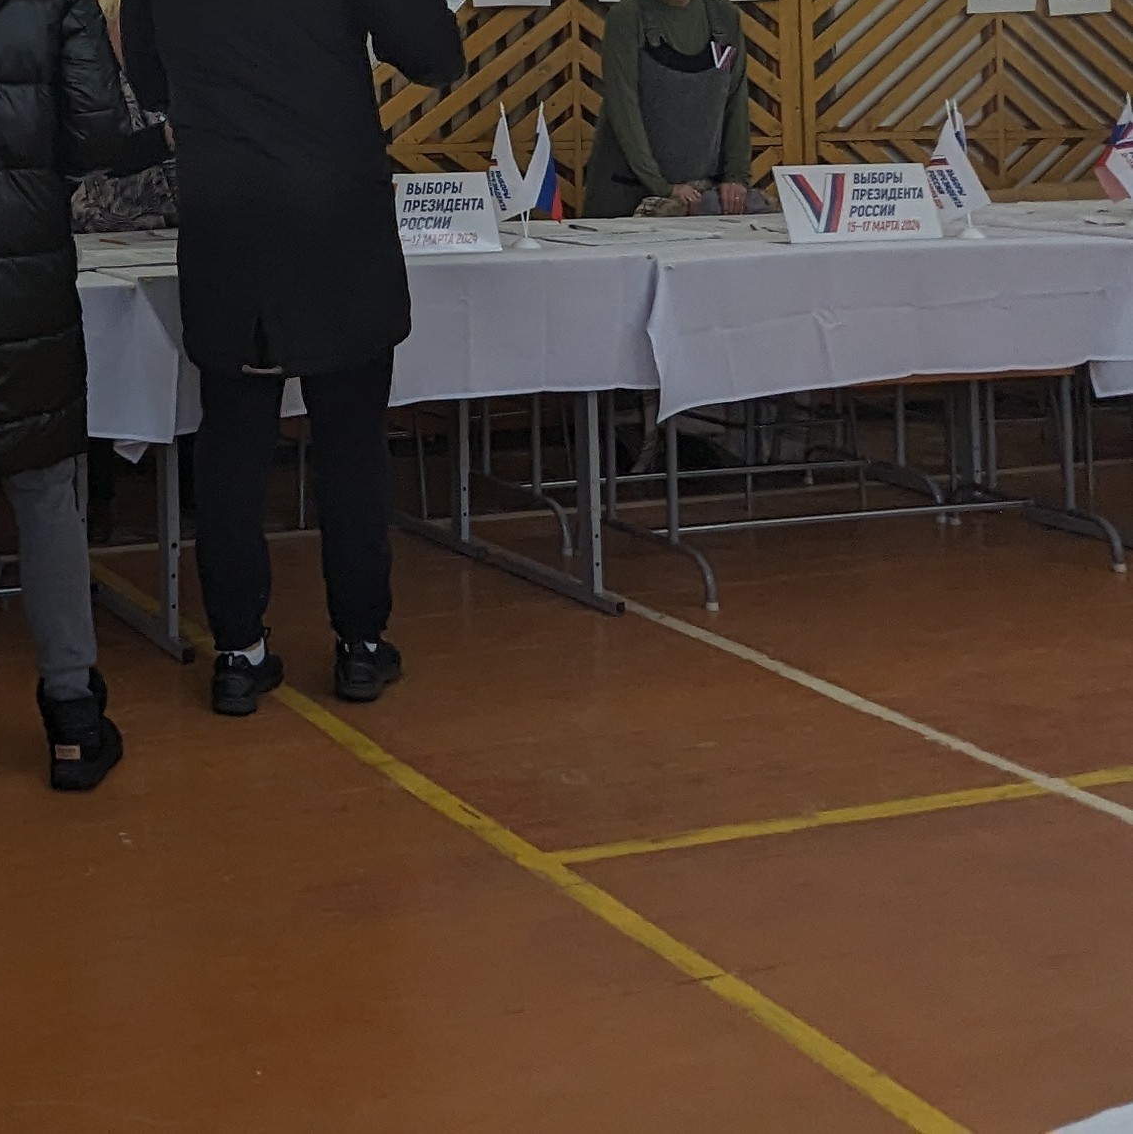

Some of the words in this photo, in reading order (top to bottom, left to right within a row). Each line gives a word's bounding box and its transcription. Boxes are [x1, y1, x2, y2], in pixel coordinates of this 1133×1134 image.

[853, 172, 903, 184] ВЫБОРЫ
[406, 181, 463, 195] ВЫБОРЫ
[851, 186, 924, 201] ПРЕЗИДЕНТА
[403, 197, 485, 213] ПРЕЗИДЕНТА
[849, 204, 896, 218] РОССИИ
[399, 216, 453, 230] РОССИИ
[871, 219, 900, 232] МАРТА
[901, 219, 921, 231] 2024
[422, 233, 454, 246] МАРТА
[455, 231, 479, 245] 2024
